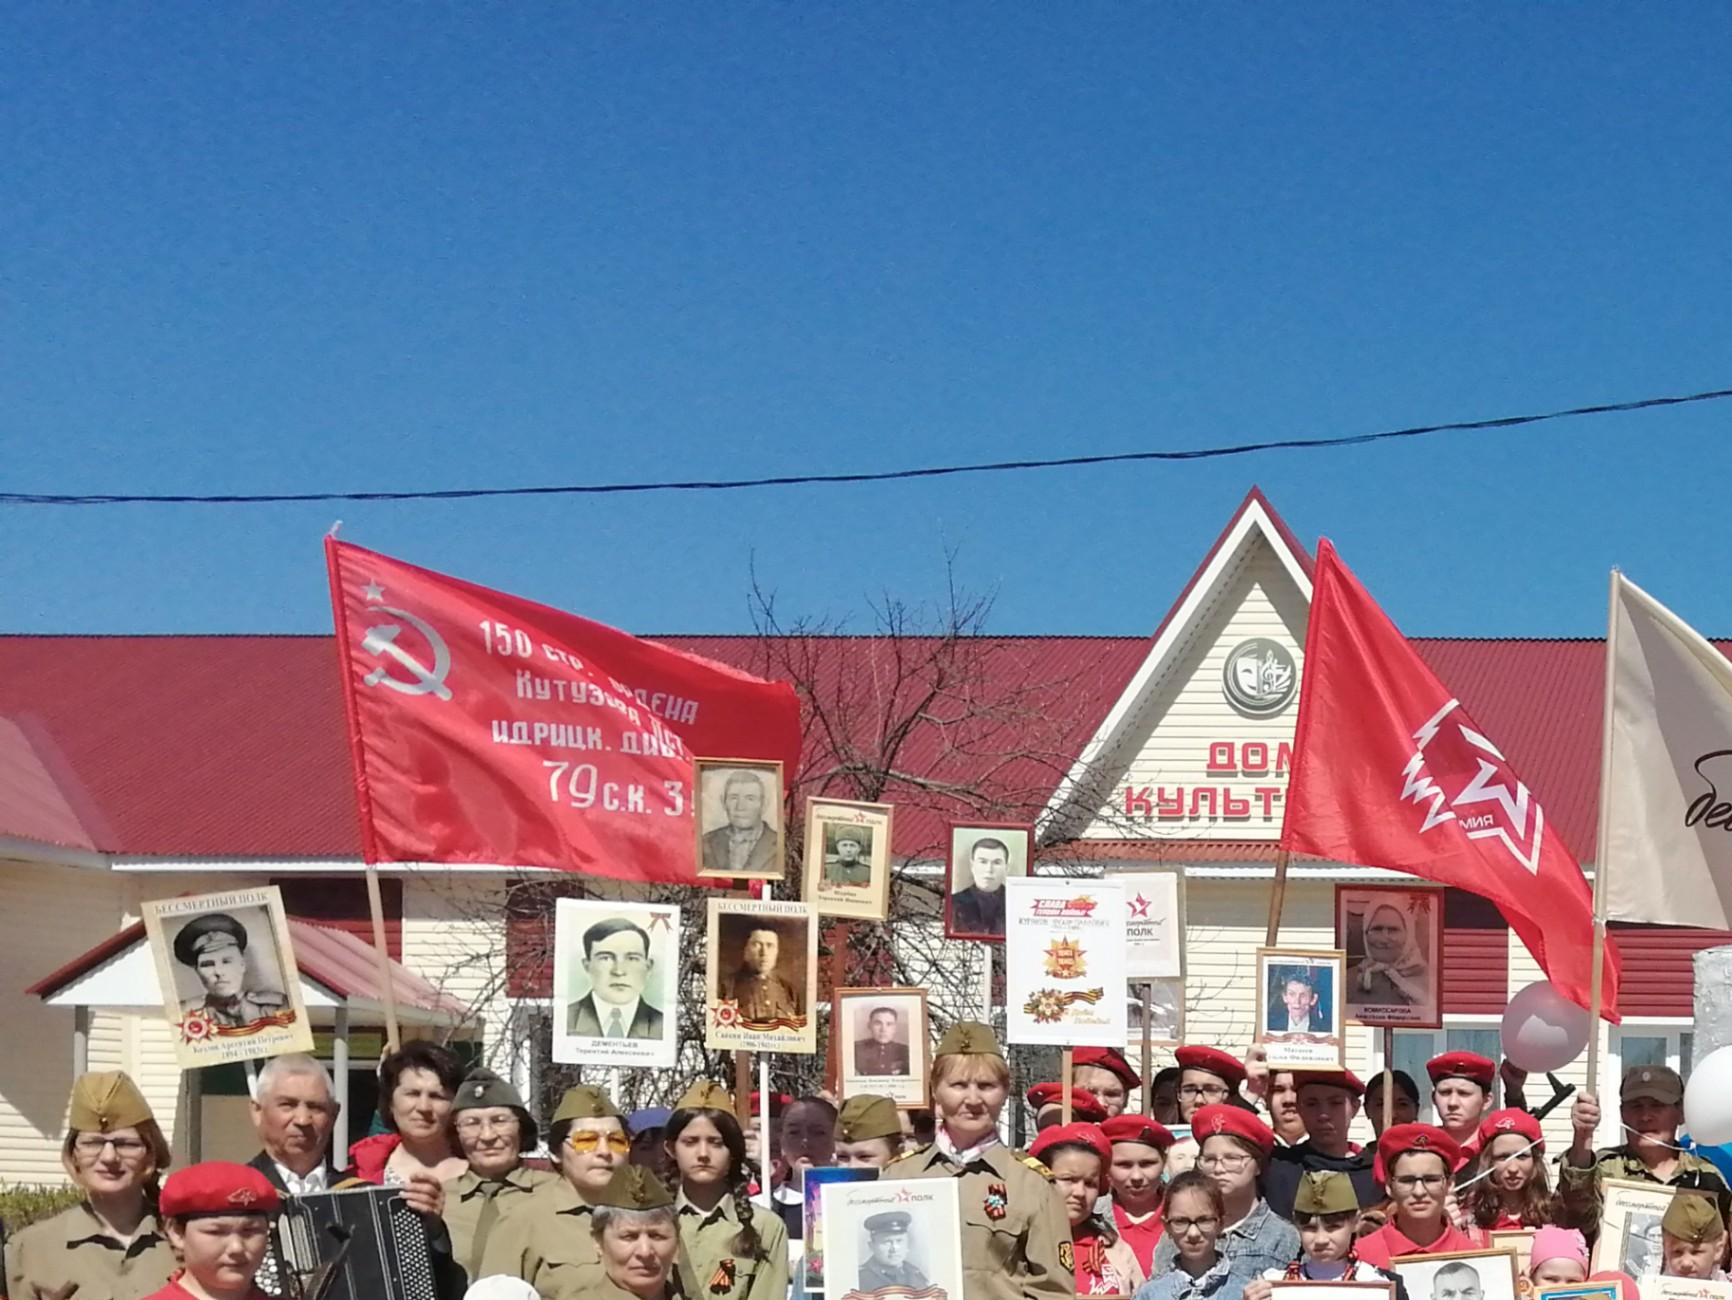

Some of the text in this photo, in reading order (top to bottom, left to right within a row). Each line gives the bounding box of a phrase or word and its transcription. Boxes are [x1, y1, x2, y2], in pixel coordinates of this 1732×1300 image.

[479, 620, 533, 658] 150
[542, 759, 599, 809] 79
[1125, 786, 1289, 816] КУЛЬТ
